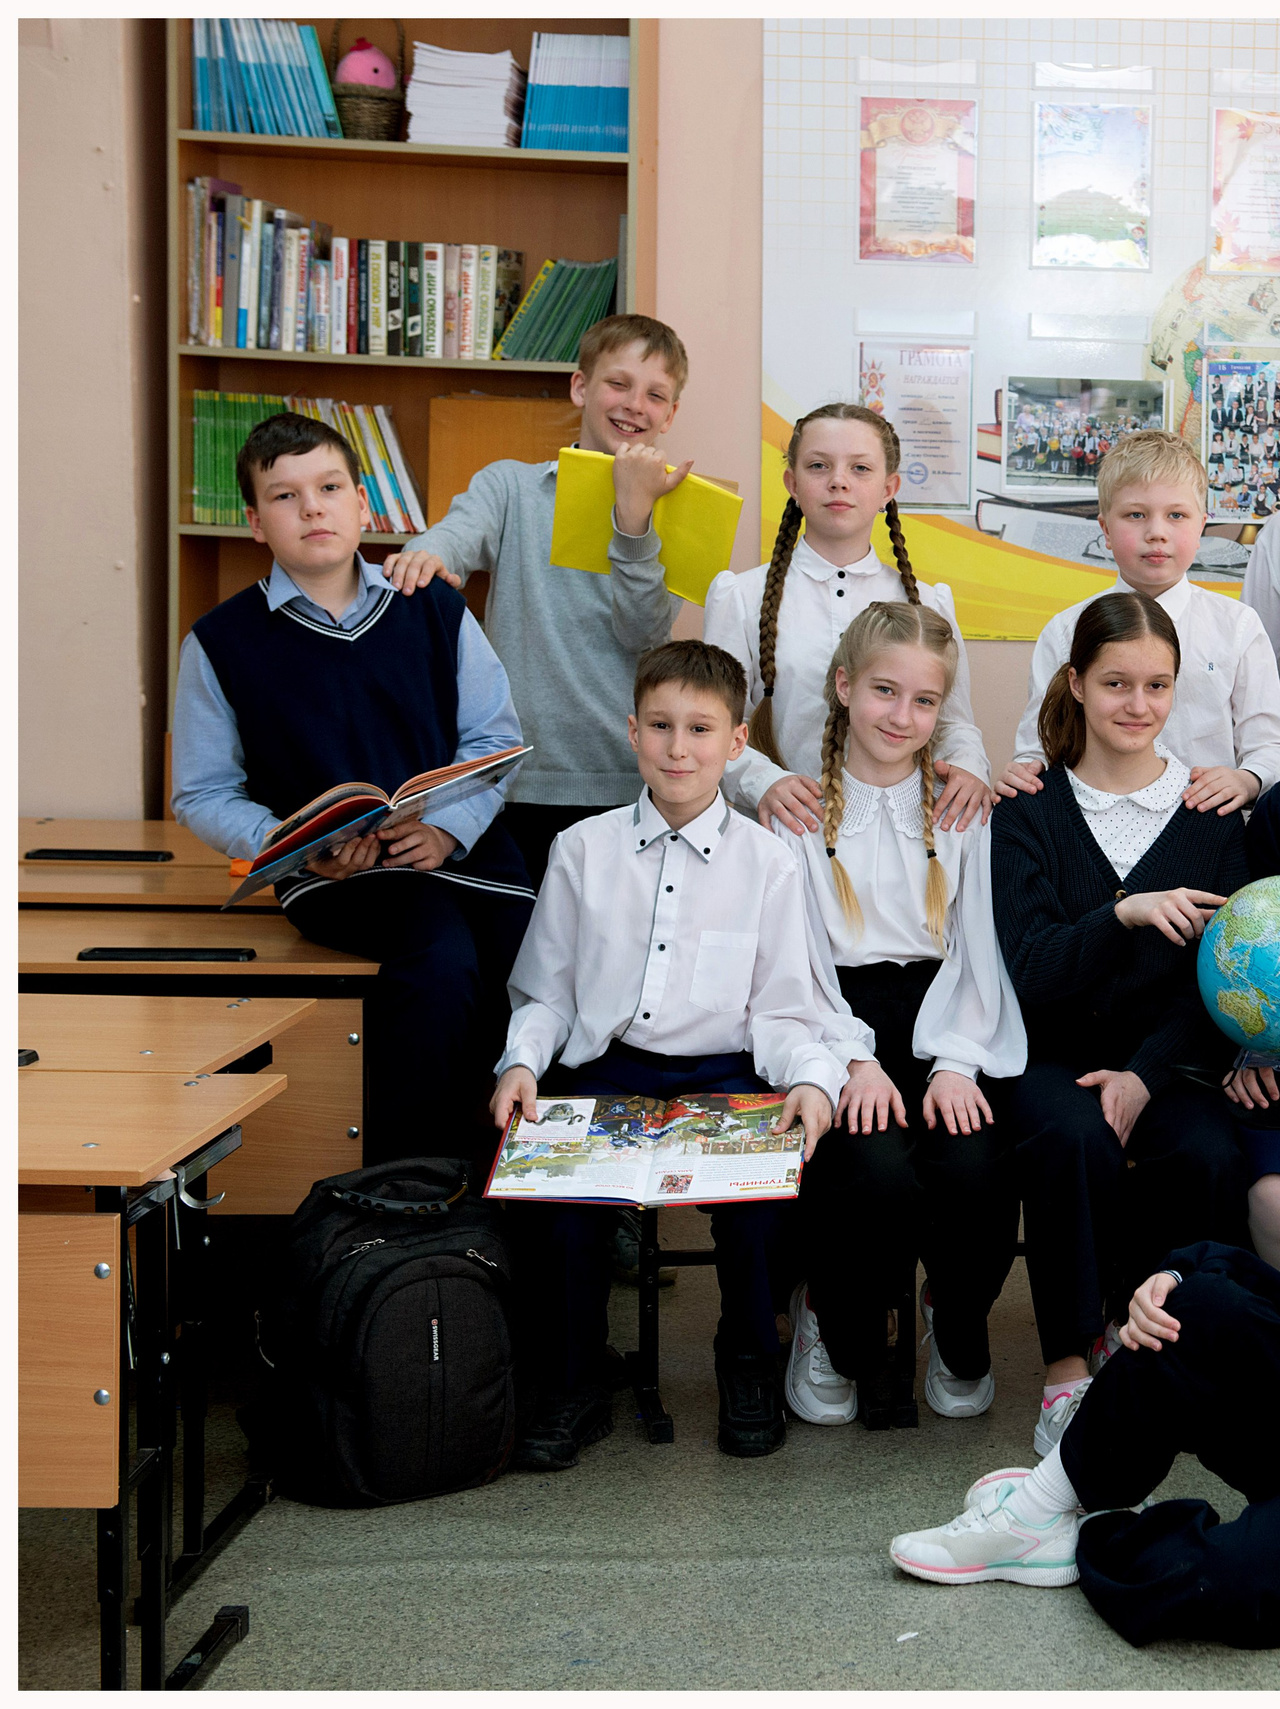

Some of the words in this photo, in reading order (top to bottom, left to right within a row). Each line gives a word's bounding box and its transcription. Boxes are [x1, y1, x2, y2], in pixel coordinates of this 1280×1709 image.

[427, 272, 437, 297] МИР
[462, 271, 472, 294] МИР
[426, 298, 437, 343] ПОЗНАЮ
[461, 297, 473, 343] ПОЗНАЮ
[425, 345, 436, 353] Я
[899, 348, 964, 368] ГРАМОТА
[729, 1178, 784, 1187] ТУРНИРЫ
[432, 1325, 440, 1361] SWISSGEAR
